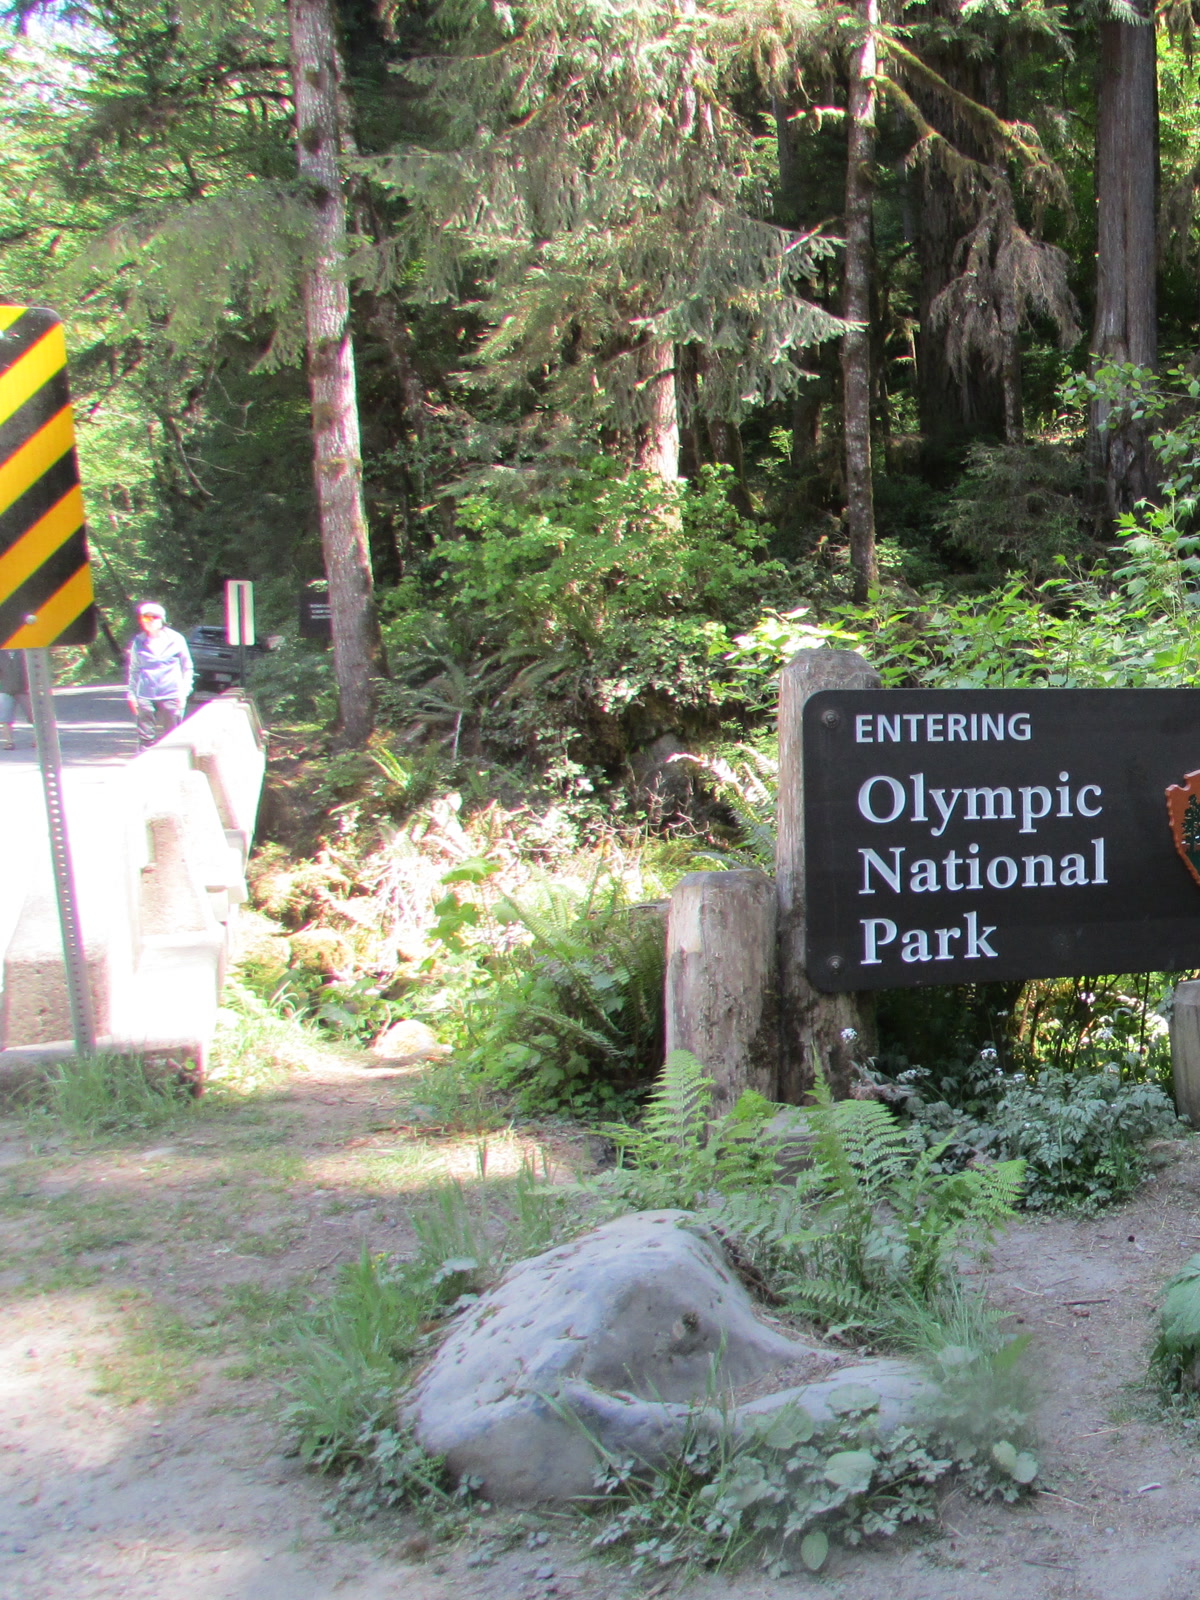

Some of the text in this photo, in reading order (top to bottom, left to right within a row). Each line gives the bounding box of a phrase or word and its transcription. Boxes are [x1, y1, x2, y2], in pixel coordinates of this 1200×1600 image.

[855, 712, 1032, 743] ENTERING
[857, 771, 1103, 837] Olympic
[857, 837, 1109, 895] National
[859, 911, 999, 965] Park
